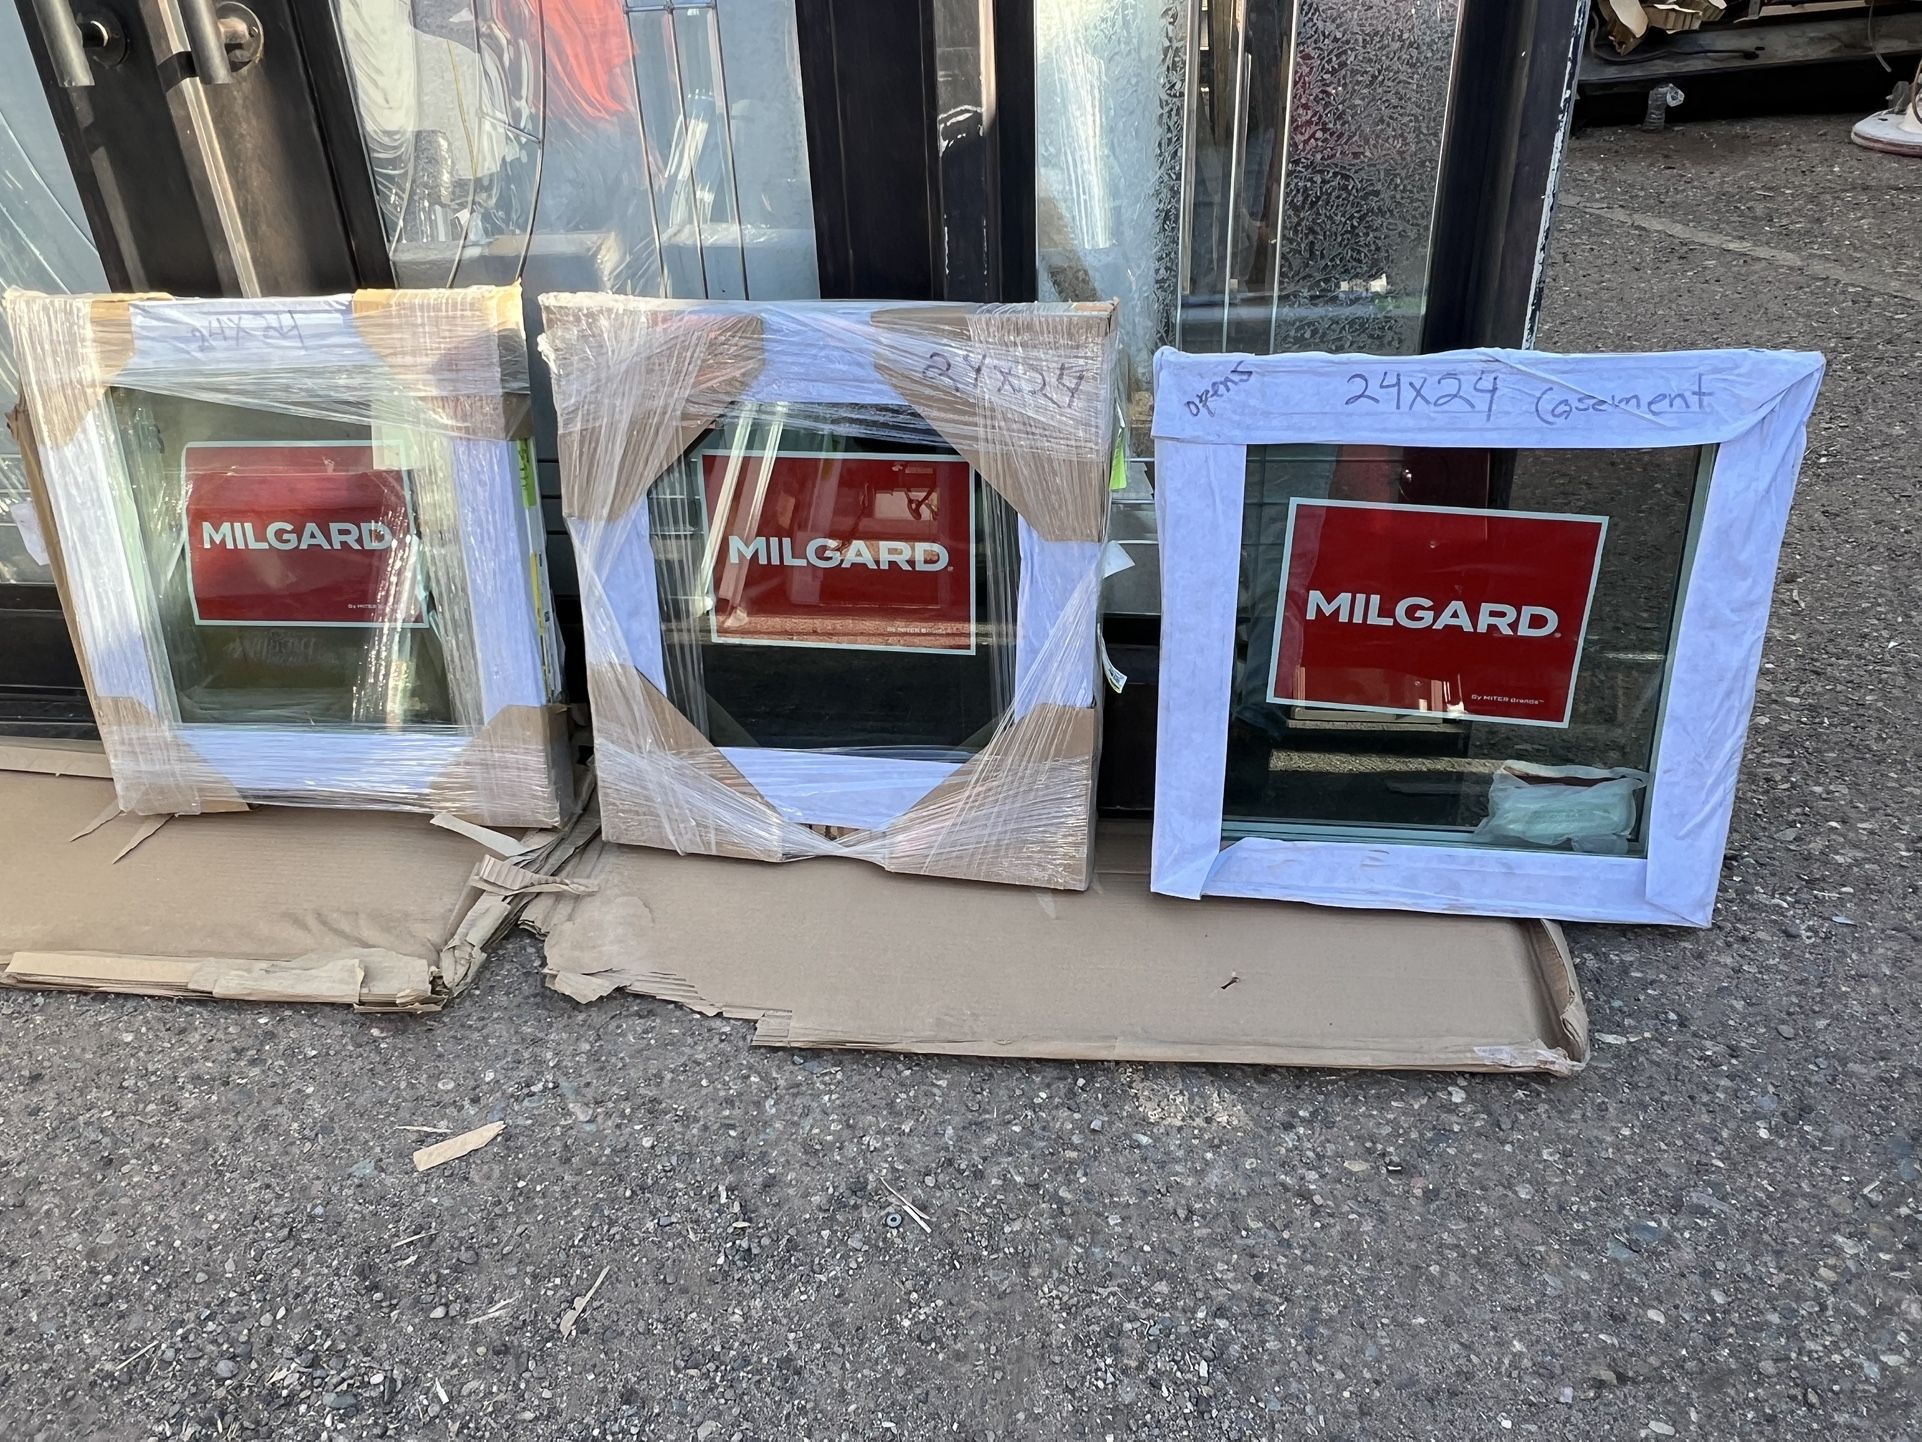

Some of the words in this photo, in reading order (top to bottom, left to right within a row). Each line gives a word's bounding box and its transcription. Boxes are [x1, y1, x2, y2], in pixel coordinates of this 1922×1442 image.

[1535, 373, 1714, 426] Casement
[202, 521, 393, 550] MILGARD
[728, 535, 950, 572] MILGARD
[1306, 589, 1560, 637] MILGARD
